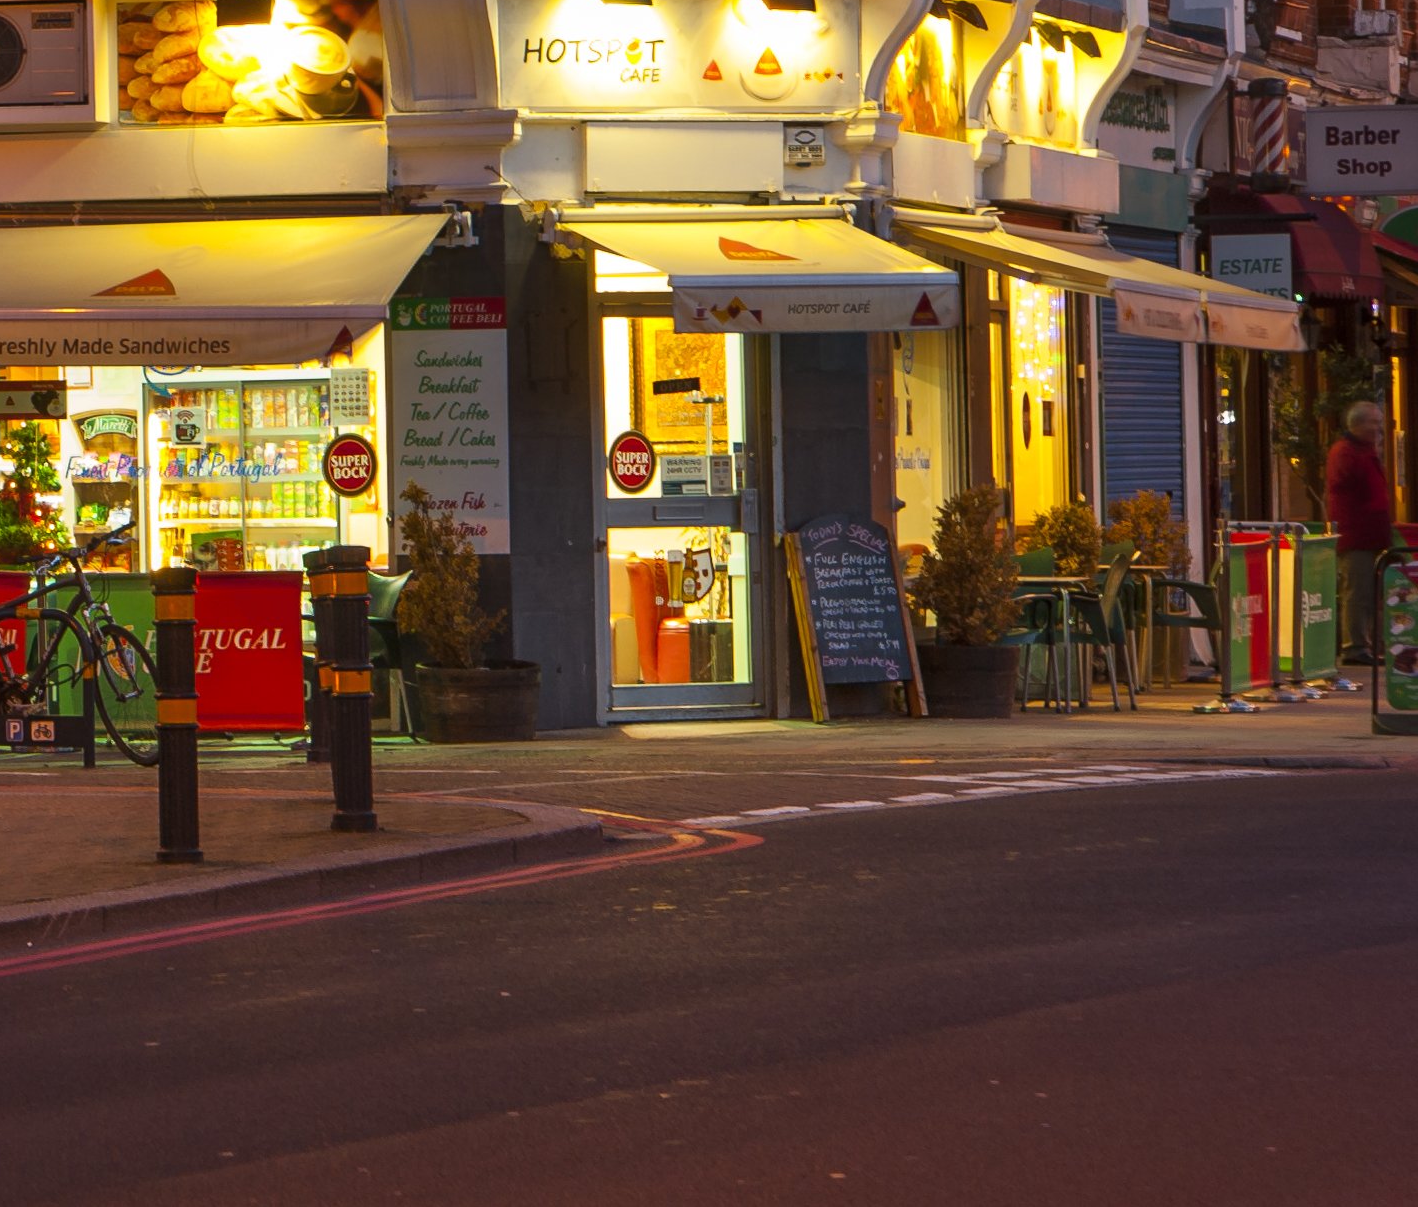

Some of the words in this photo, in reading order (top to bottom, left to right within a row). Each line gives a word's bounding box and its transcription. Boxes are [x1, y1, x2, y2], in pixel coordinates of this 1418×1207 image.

[619, 67, 660, 83] CAFE
[1325, 125, 1400, 146] Barber
[1337, 158, 1392, 177] Shop
[1219, 257, 1283, 275] ESTATE
[430, 303, 487, 314] PORTUGAL
[787, 303, 840, 315] HOTSPOT
[842, 300, 871, 314] CAFÉ
[430, 314, 474, 324] COFFEE
[476, 313, 502, 324] DELI
[63, 338, 113, 355] Made
[119, 337, 230, 355] Sandwiches
[414, 349, 483, 368] Sandwiches
[418, 375, 481, 394] Breakfast
[411, 403, 432, 421] Tea
[448, 402, 489, 421] Coffee
[403, 428, 443, 447] Bread
[459, 428, 496, 447] Cakes
[331, 453, 370, 468] SUPER
[400, 455, 426, 469] Freshly
[427, 455, 449, 467] Made
[616, 450, 649, 465] SUPER
[209, 451, 282, 483] Portugal
[334, 467, 368, 480] BOCK
[618, 463, 648, 476] BOCK
[421, 492, 459, 510] rozen
[460, 491, 487, 511] Fish
[814, 553, 838, 566] FULL
[841, 552, 887, 566] ENGLISH
[145, 627, 287, 650] PTUGAL
